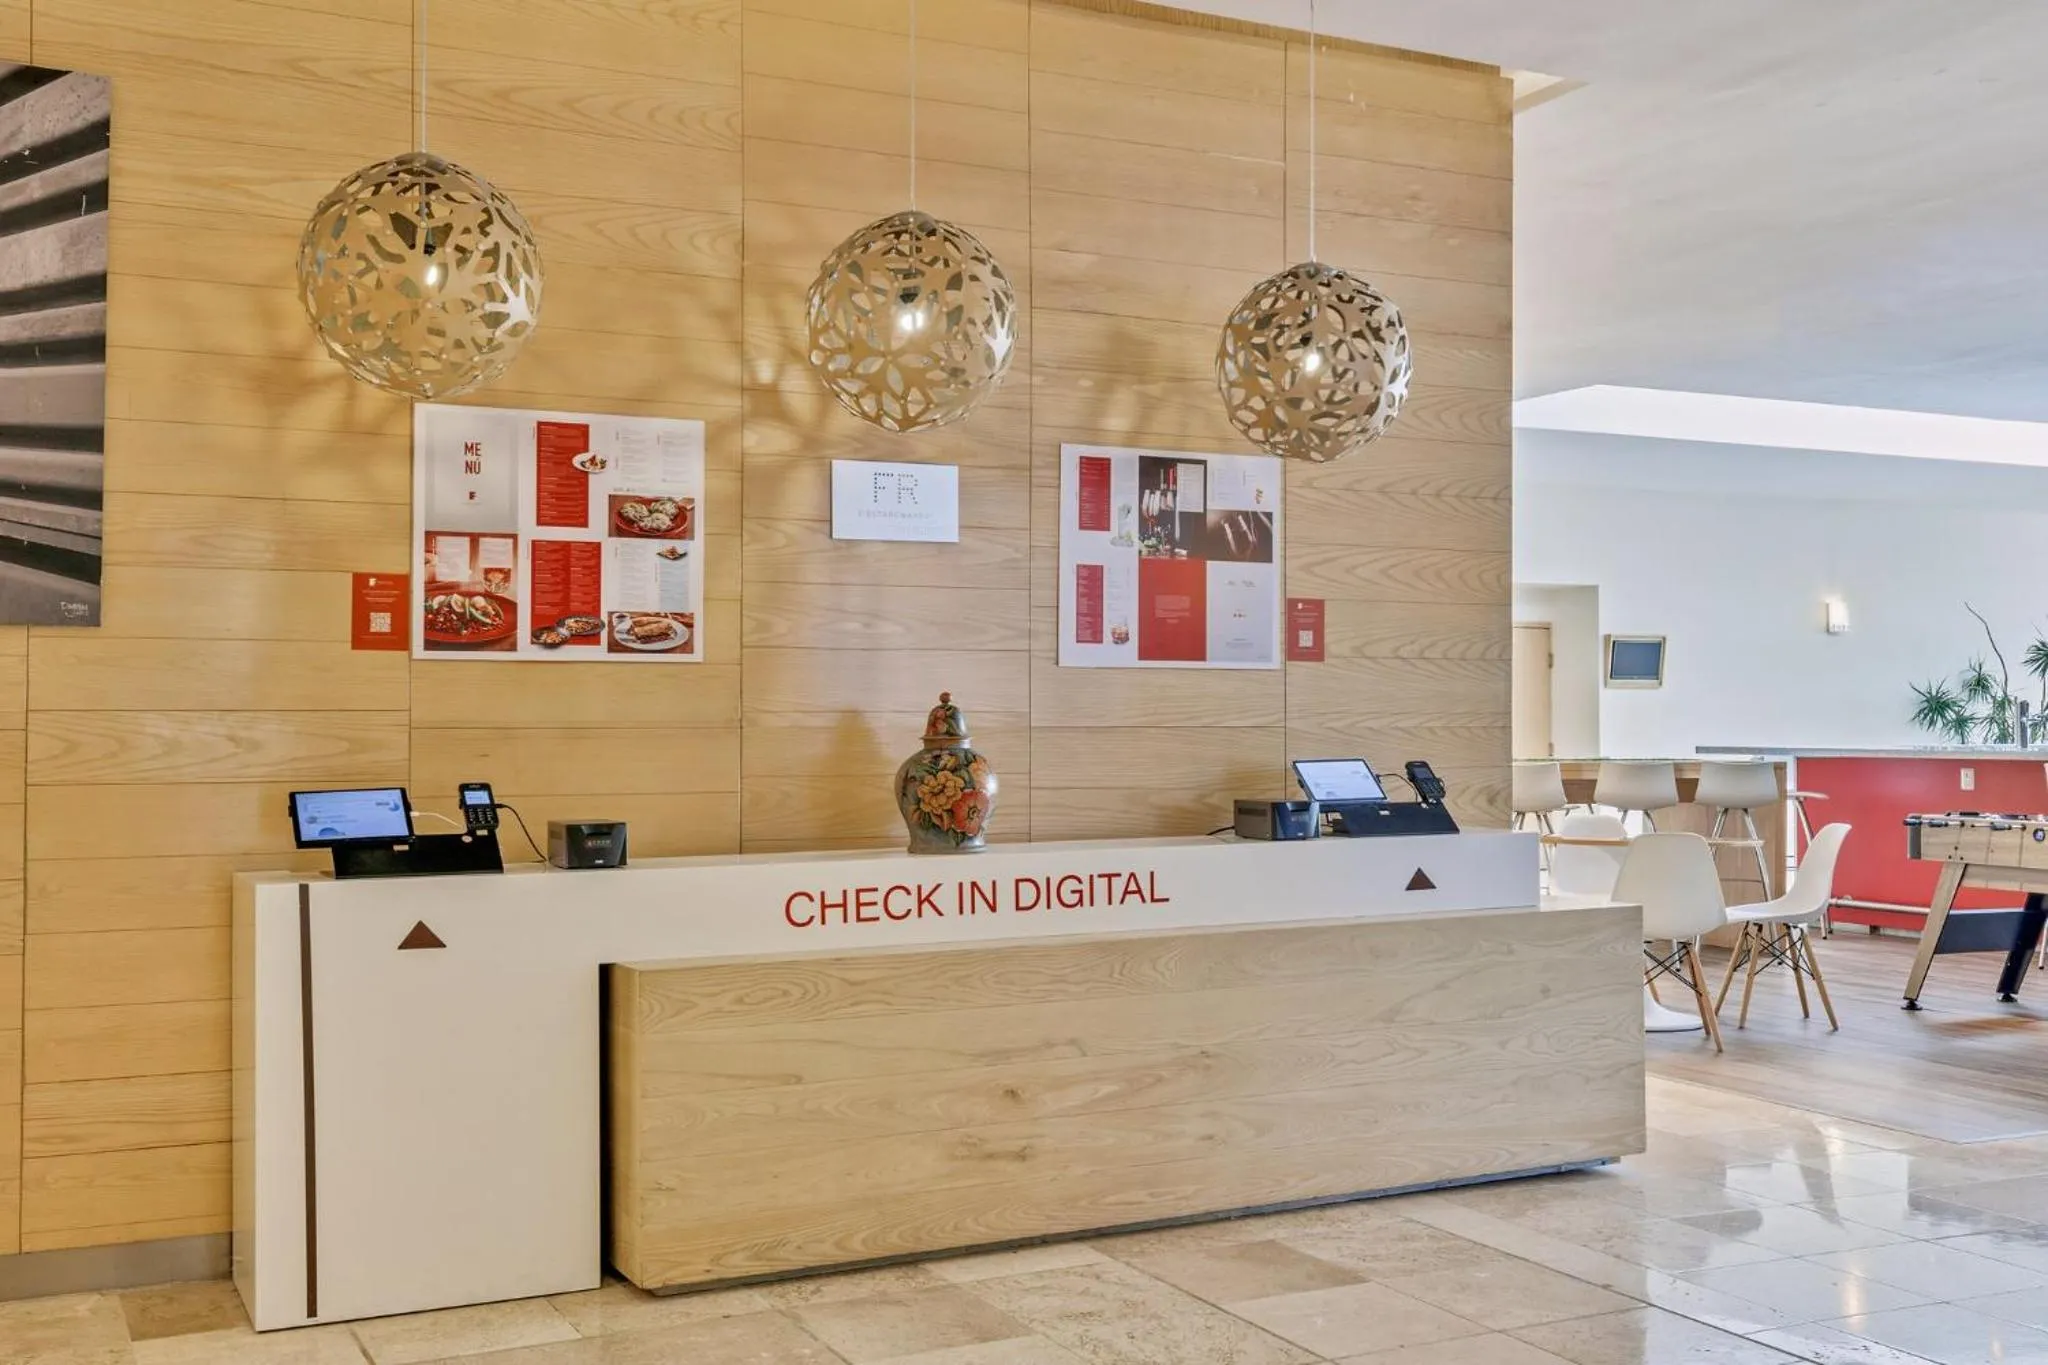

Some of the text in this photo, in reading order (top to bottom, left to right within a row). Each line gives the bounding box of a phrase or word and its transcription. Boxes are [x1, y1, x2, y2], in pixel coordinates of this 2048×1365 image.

[464, 441, 482, 457] ME
[464, 458, 482, 475] NÚ
[873, 472, 919, 505] FR
[785, 871, 1170, 928] CHECK IN DIGITAL
